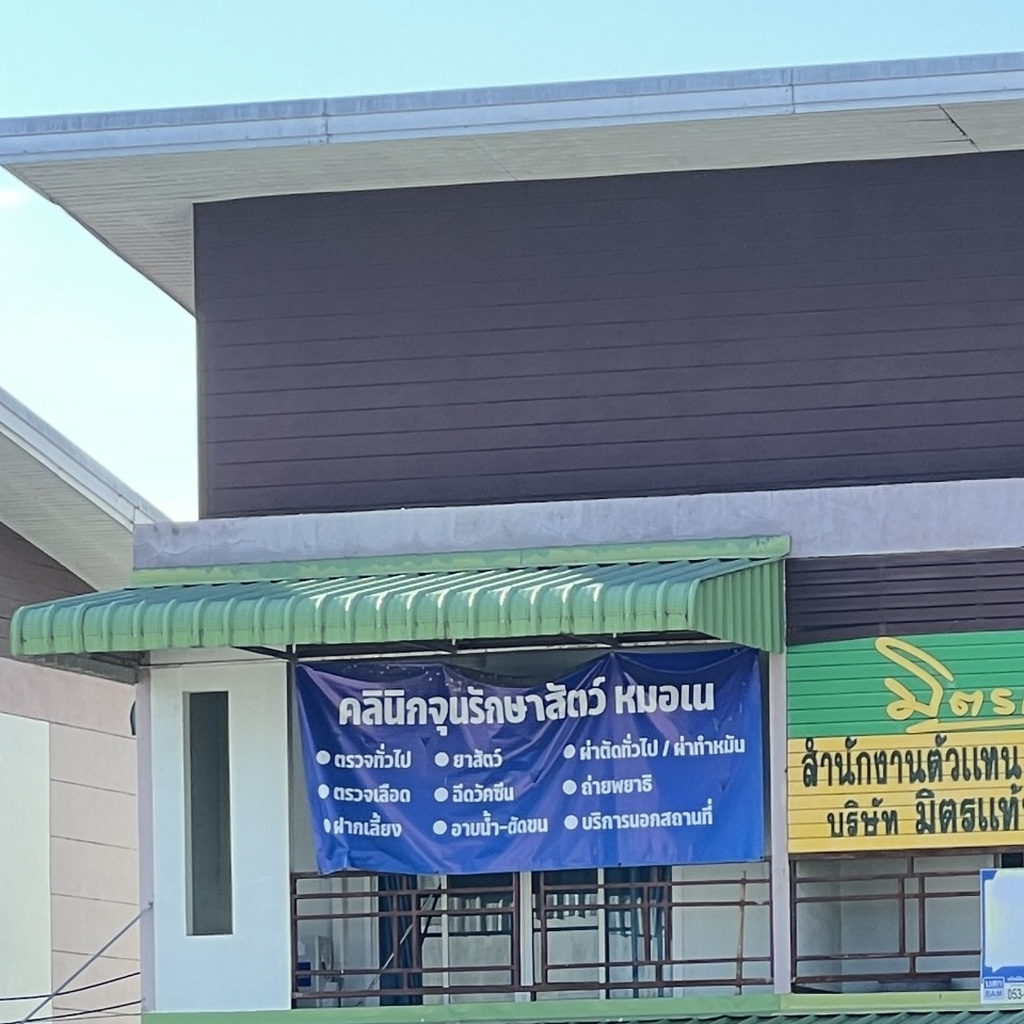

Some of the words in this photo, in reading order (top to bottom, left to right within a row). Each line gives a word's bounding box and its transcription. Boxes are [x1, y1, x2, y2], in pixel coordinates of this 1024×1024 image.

[339, 676, 606, 736] คลินิกจุนรักษาสัตว์
[615, 683, 715, 714] หมอเน
[335, 743, 411, 768] ตรวจทั่วไป
[453, 749, 503, 768] ยาสัตว์
[580, 734, 658, 760] ผ่าตัดทั่วไป
[674, 734, 746, 756] ผ่าทำหมัน
[802, 734, 1022, 787] สำนักงานตัวแทน
[333, 783, 411, 803] ตรวจเลือด
[453, 782, 514, 802] ฉีดวัคซีน
[581, 774, 653, 795] ถ่ายพยาธิ
[333, 812, 402, 838] ฝากเลี้ยง
[451, 810, 548, 837] อาบน้ำ-ตัดขน
[582, 798, 713, 830] บริการนอกสถานที่
[828, 797, 898, 837] บริษัท
[985, 989, 1003, 998] BAM
